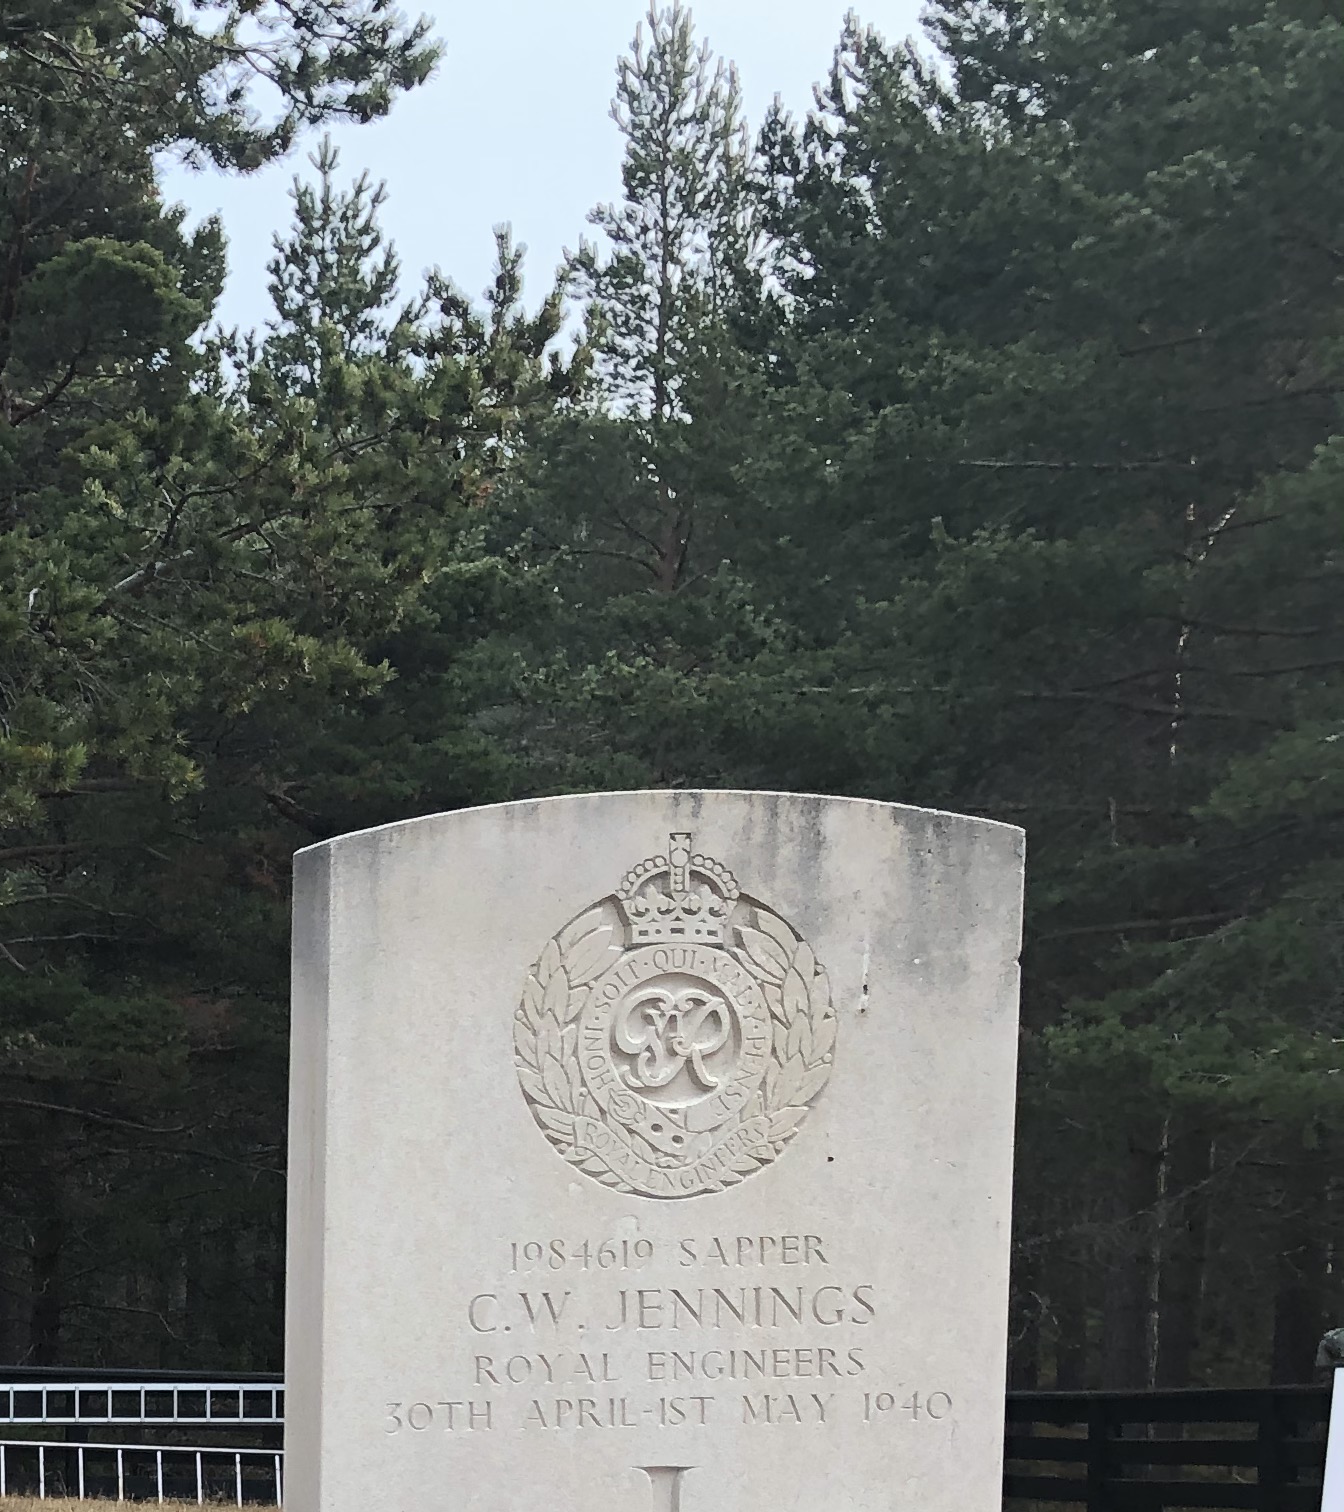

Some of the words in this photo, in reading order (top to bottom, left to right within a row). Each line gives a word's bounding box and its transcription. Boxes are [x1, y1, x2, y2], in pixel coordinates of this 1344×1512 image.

[653, 949, 698, 971] QUI
[595, 959, 640, 1015] SOIT
[585, 1025, 616, 1090] HONI
[585, 1122, 639, 1181] ROYAL
[642, 1122, 767, 1190] ENGINEERS
[511, 1239, 653, 1273] 1984619
[680, 1234, 831, 1268] SAPPER
[468, 1291, 586, 1334] C.W.
[604, 1284, 878, 1332] JENNINGS
[473, 1352, 620, 1387] ROYAL
[647, 1347, 867, 1382] ENGINEERS
[385, 1399, 493, 1434] 30TH
[742, 1392, 836, 1427] MAY
[863, 1391, 954, 1424] 1940
